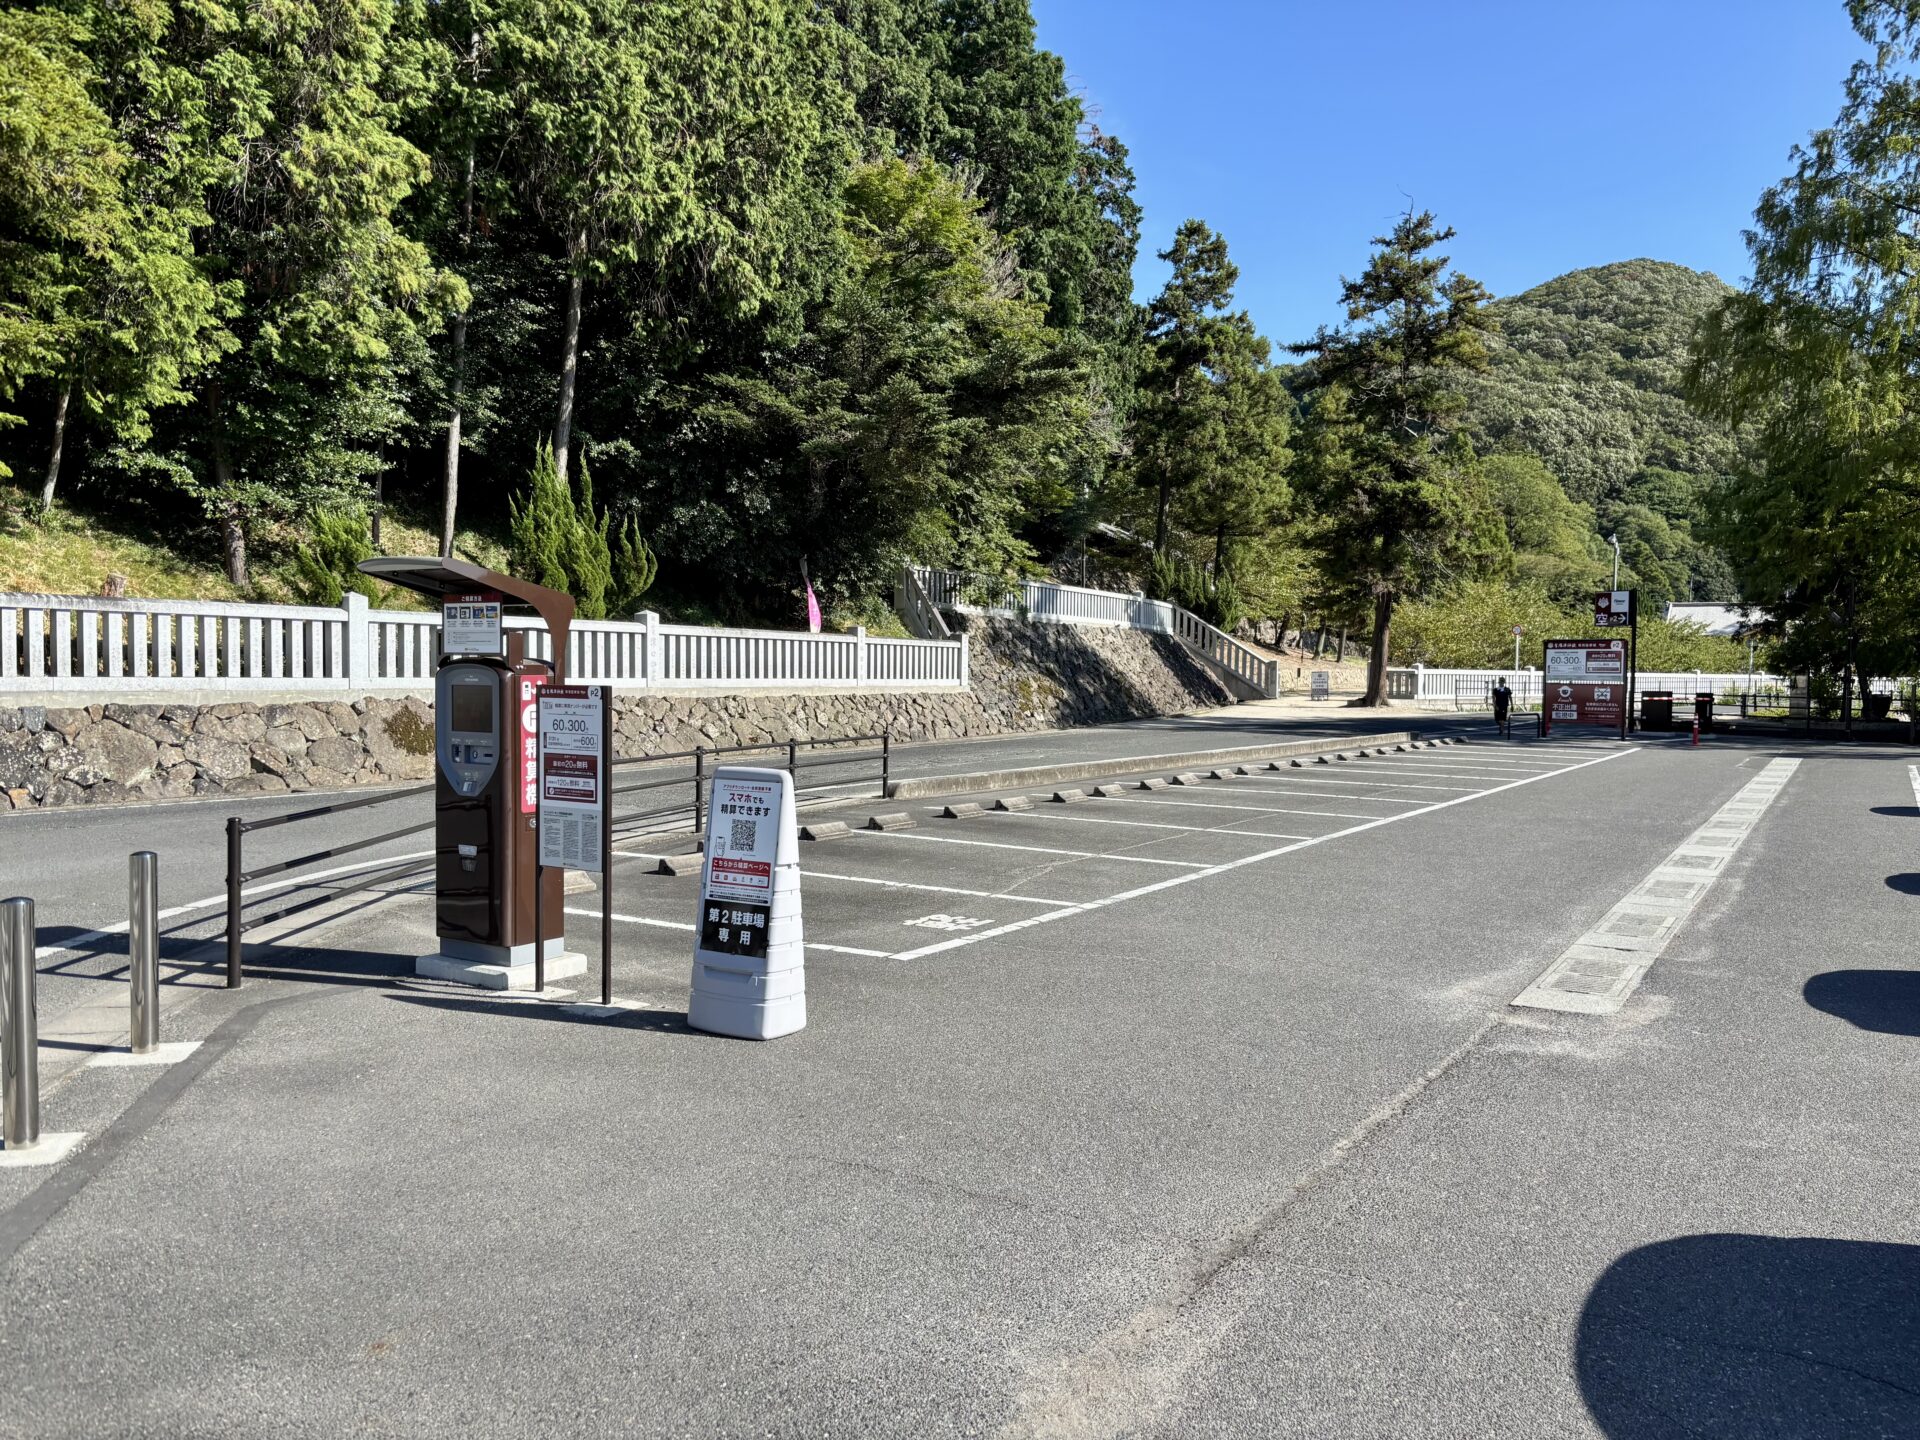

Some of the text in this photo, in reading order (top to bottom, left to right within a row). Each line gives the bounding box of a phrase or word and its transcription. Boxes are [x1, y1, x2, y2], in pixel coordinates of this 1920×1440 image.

[1596, 612, 1608, 625] 空
[729, 793, 764, 804] スマホでも
[721, 804, 771, 816] 精算できます
[714, 860, 769, 870] こちらから精算ページへ
[708, 908, 765, 928] 第2駐車場
